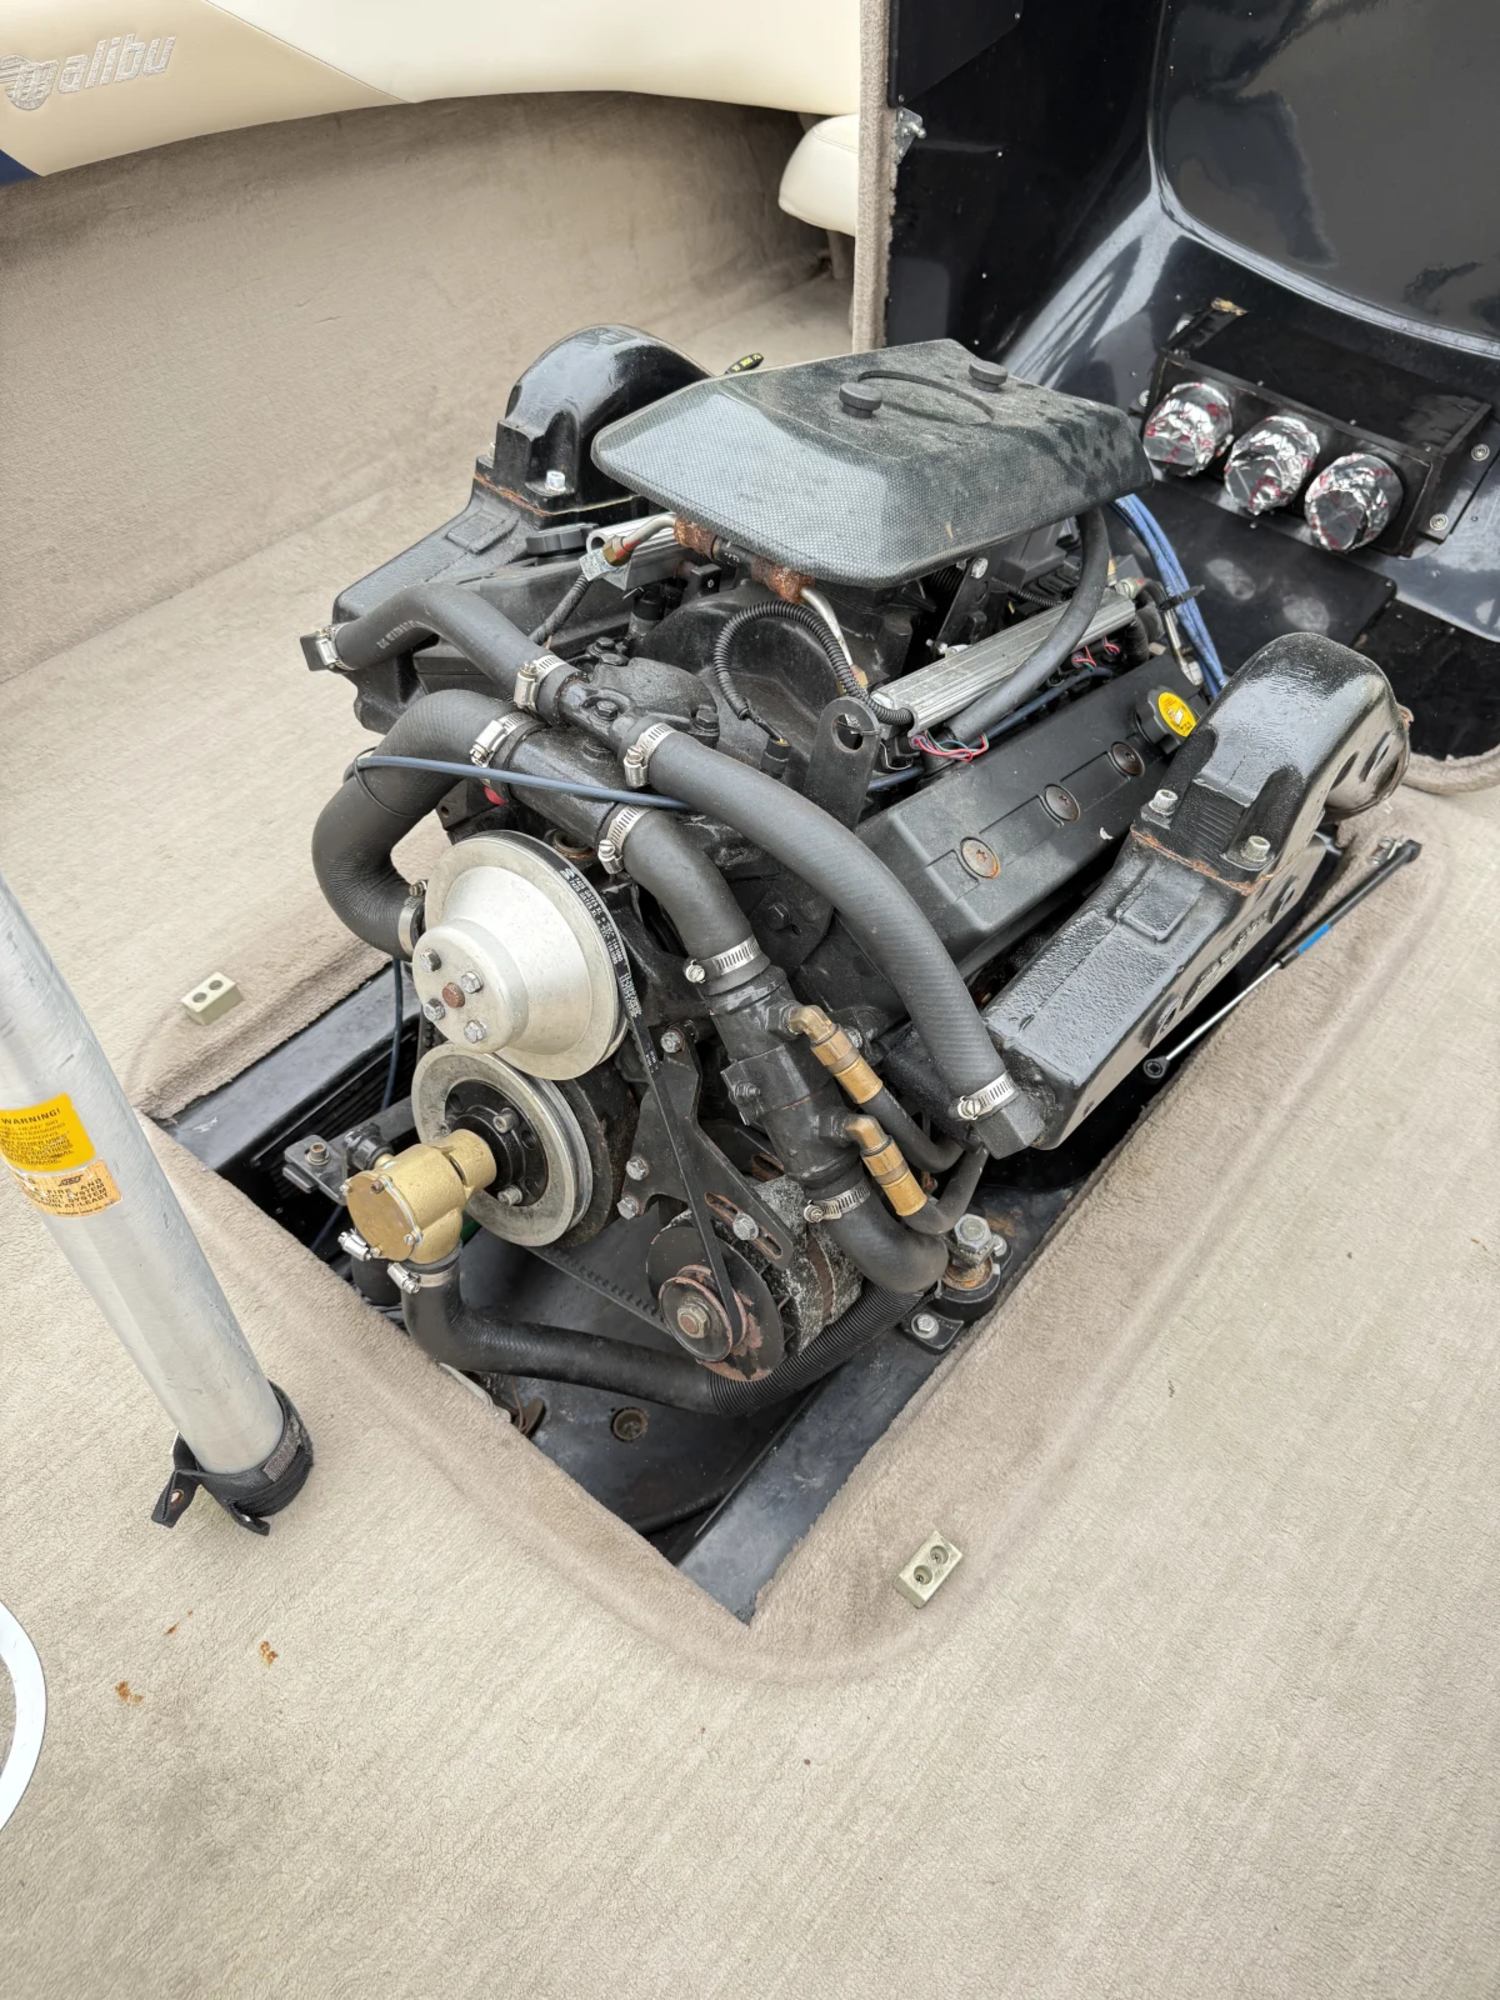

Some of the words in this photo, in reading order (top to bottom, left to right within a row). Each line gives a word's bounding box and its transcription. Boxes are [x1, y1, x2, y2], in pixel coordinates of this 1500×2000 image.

[1, 1107, 61, 1125] WARNING!
[80, 1178, 102, 1190] AND
[68, 1188, 107, 1203] SYSTEM
